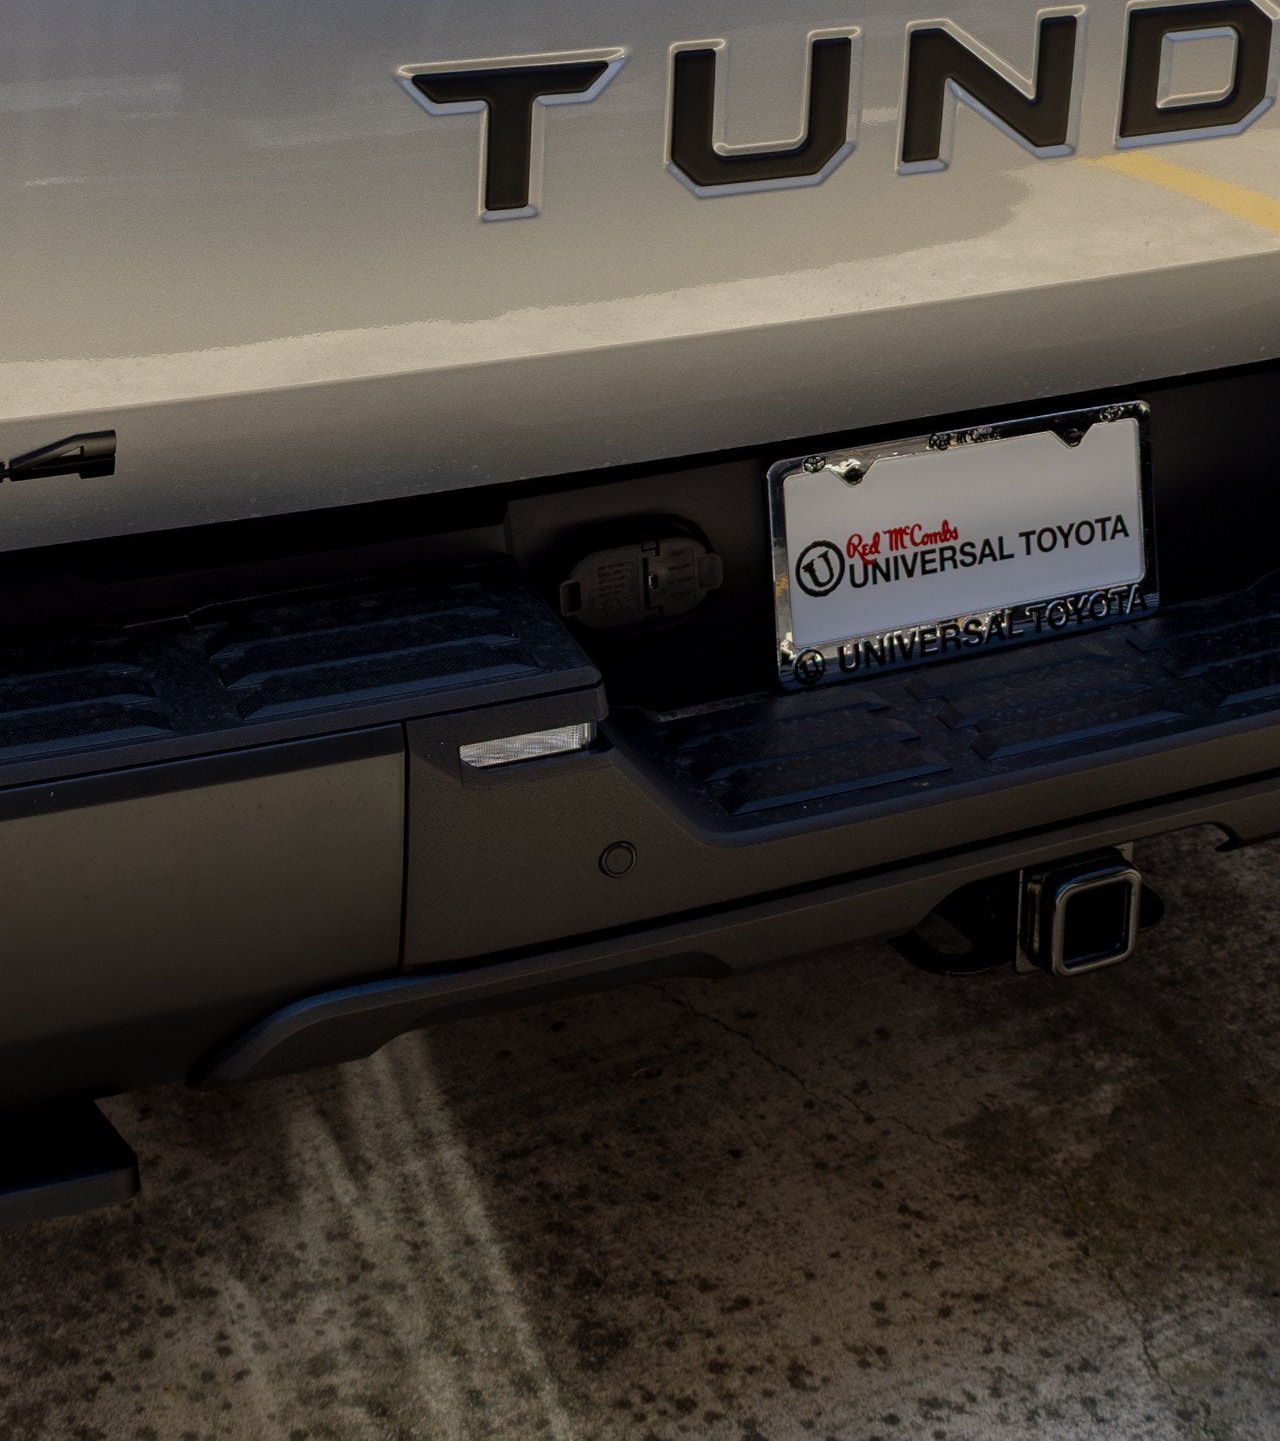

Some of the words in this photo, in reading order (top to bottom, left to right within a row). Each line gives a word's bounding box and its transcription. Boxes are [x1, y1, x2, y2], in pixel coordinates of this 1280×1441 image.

[846, 531, 882, 566] Red
[882, 519, 959, 552] McCombs
[848, 535, 1015, 589] UNIVERSAL
[1018, 514, 1131, 556] TOYOTA
[837, 608, 1025, 674] UNIVERSAL
[1026, 584, 1149, 634] TOYOTA
